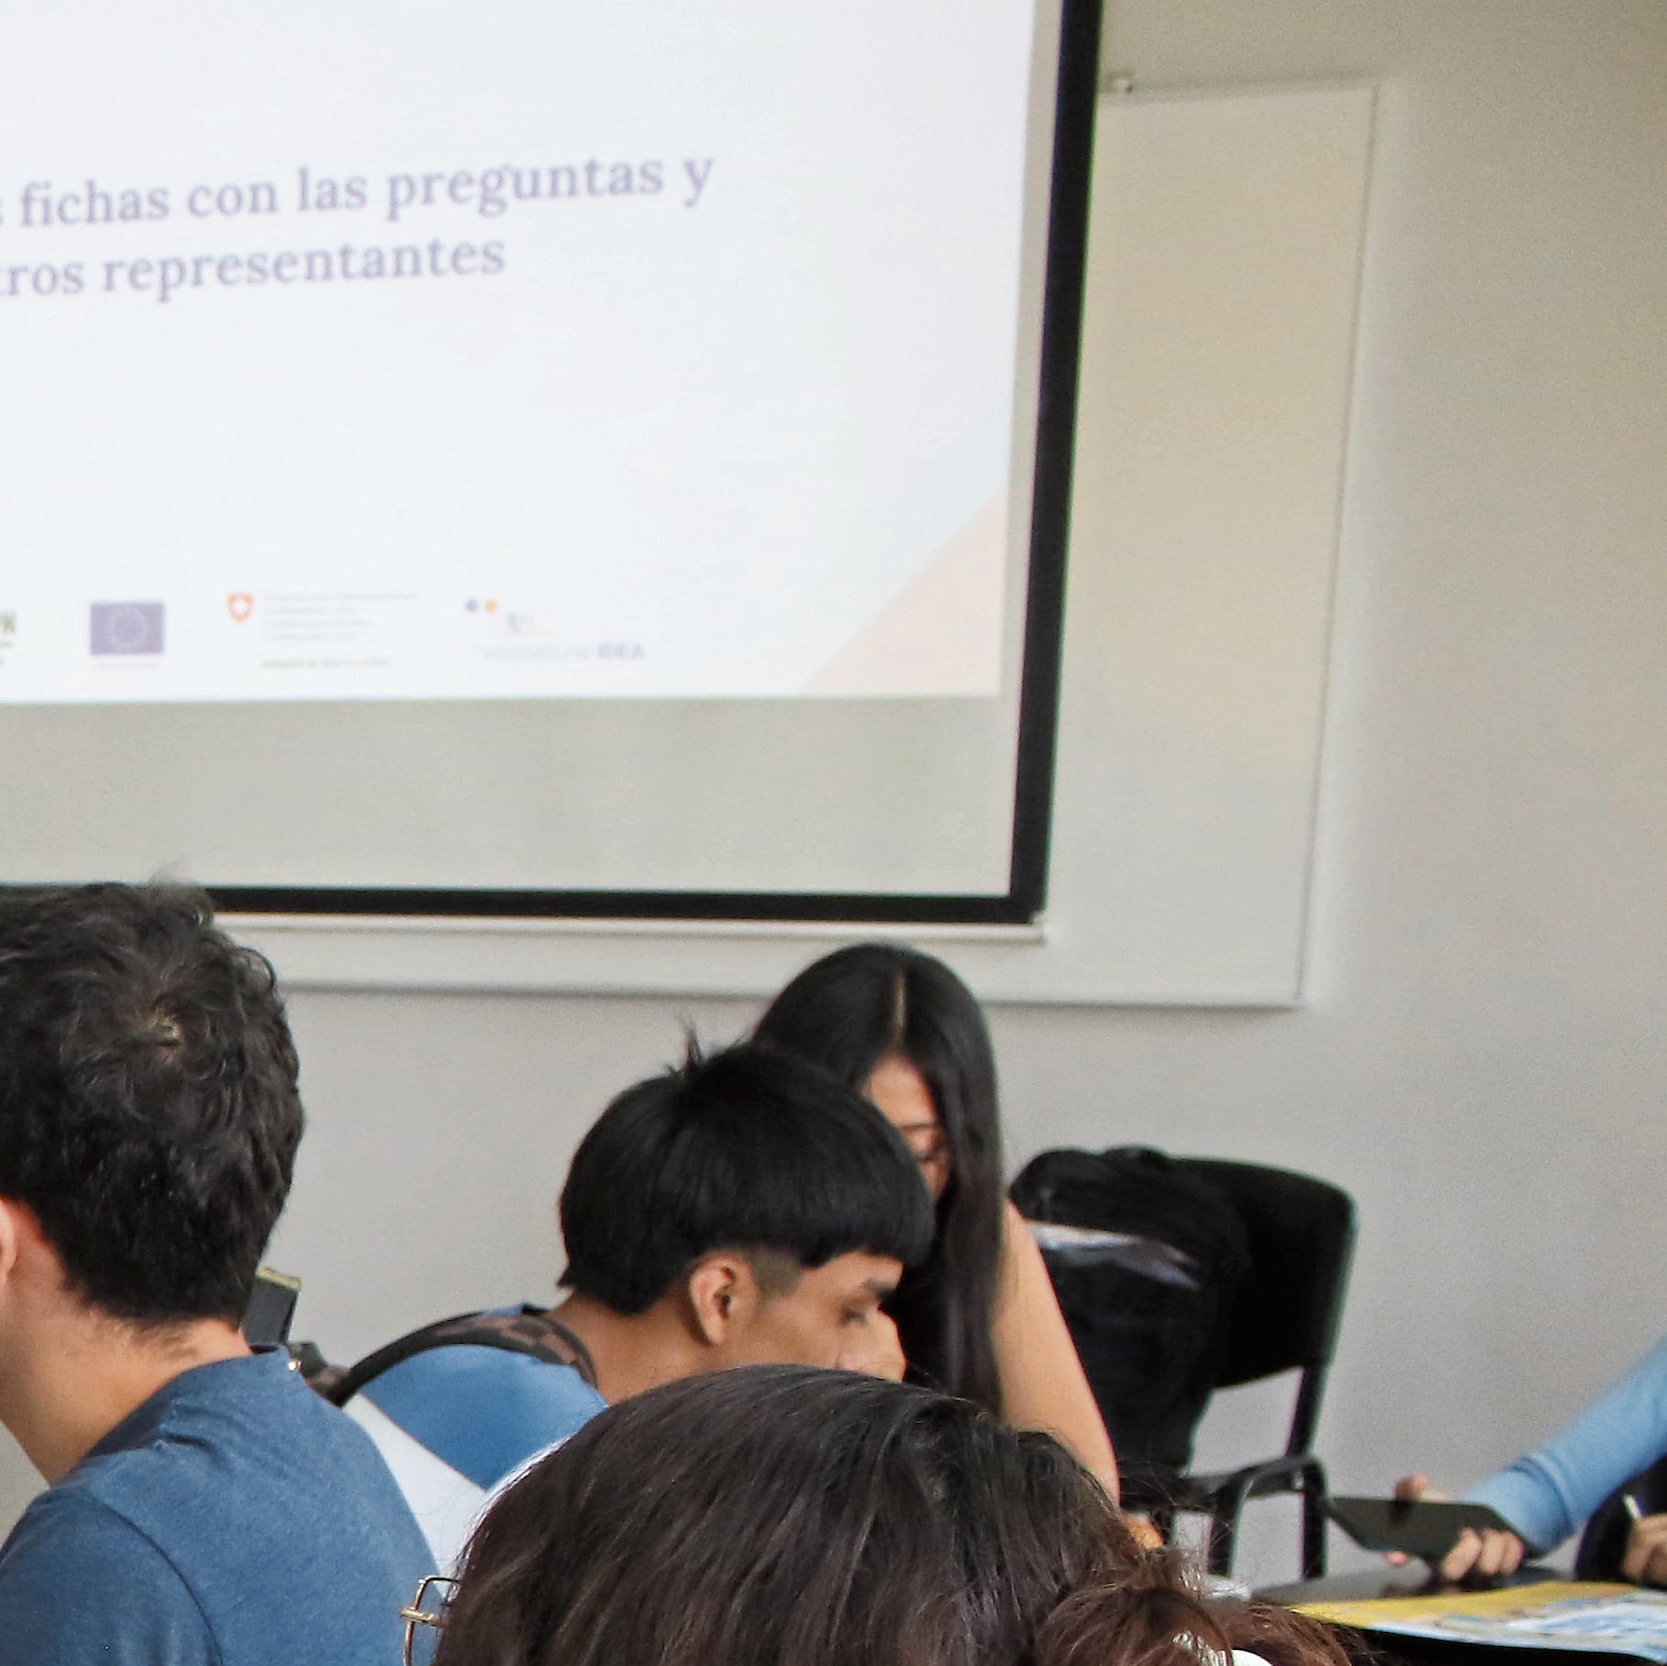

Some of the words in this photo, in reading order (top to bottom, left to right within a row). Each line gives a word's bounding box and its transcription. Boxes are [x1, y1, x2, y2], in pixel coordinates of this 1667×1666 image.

[21, 180, 171, 228] fichas
[187, 183, 278, 218] con
[299, 167, 368, 212] las
[388, 159, 665, 223] preguntas
[684, 160, 714, 208] y
[104, 239, 506, 305] representantes
